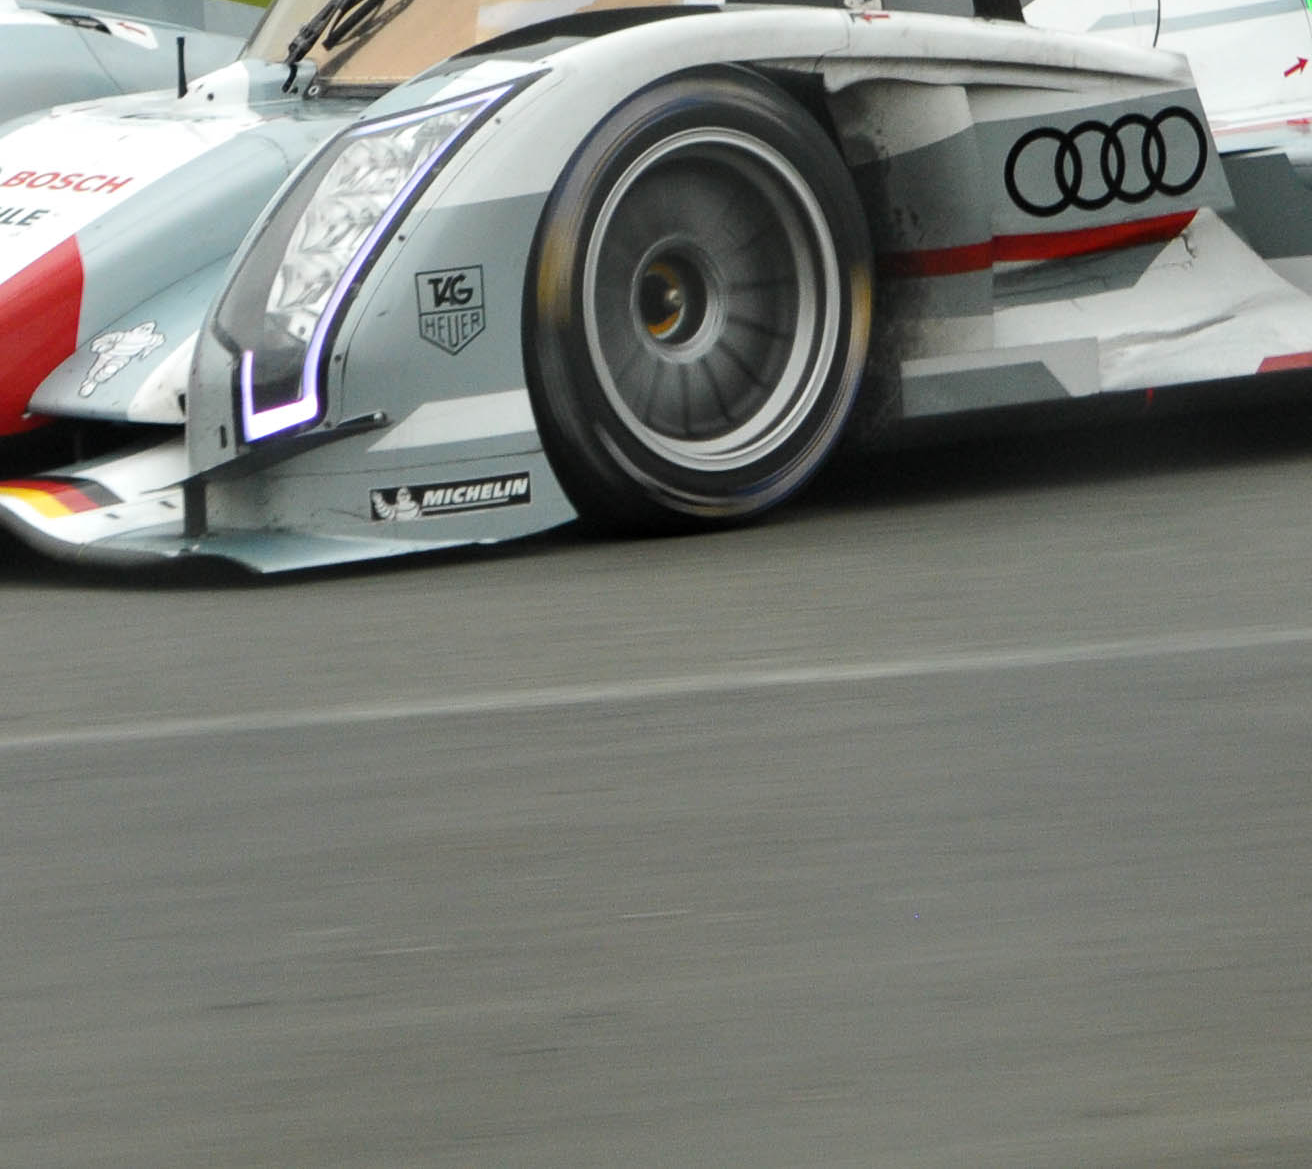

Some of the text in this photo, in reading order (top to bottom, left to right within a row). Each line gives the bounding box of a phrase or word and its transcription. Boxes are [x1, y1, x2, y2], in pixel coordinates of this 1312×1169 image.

[0, 171, 134, 194] BOSCH
[428, 273, 473, 307] TAG
[424, 311, 481, 348] HEUER
[422, 478, 529, 507] MICHELIN
